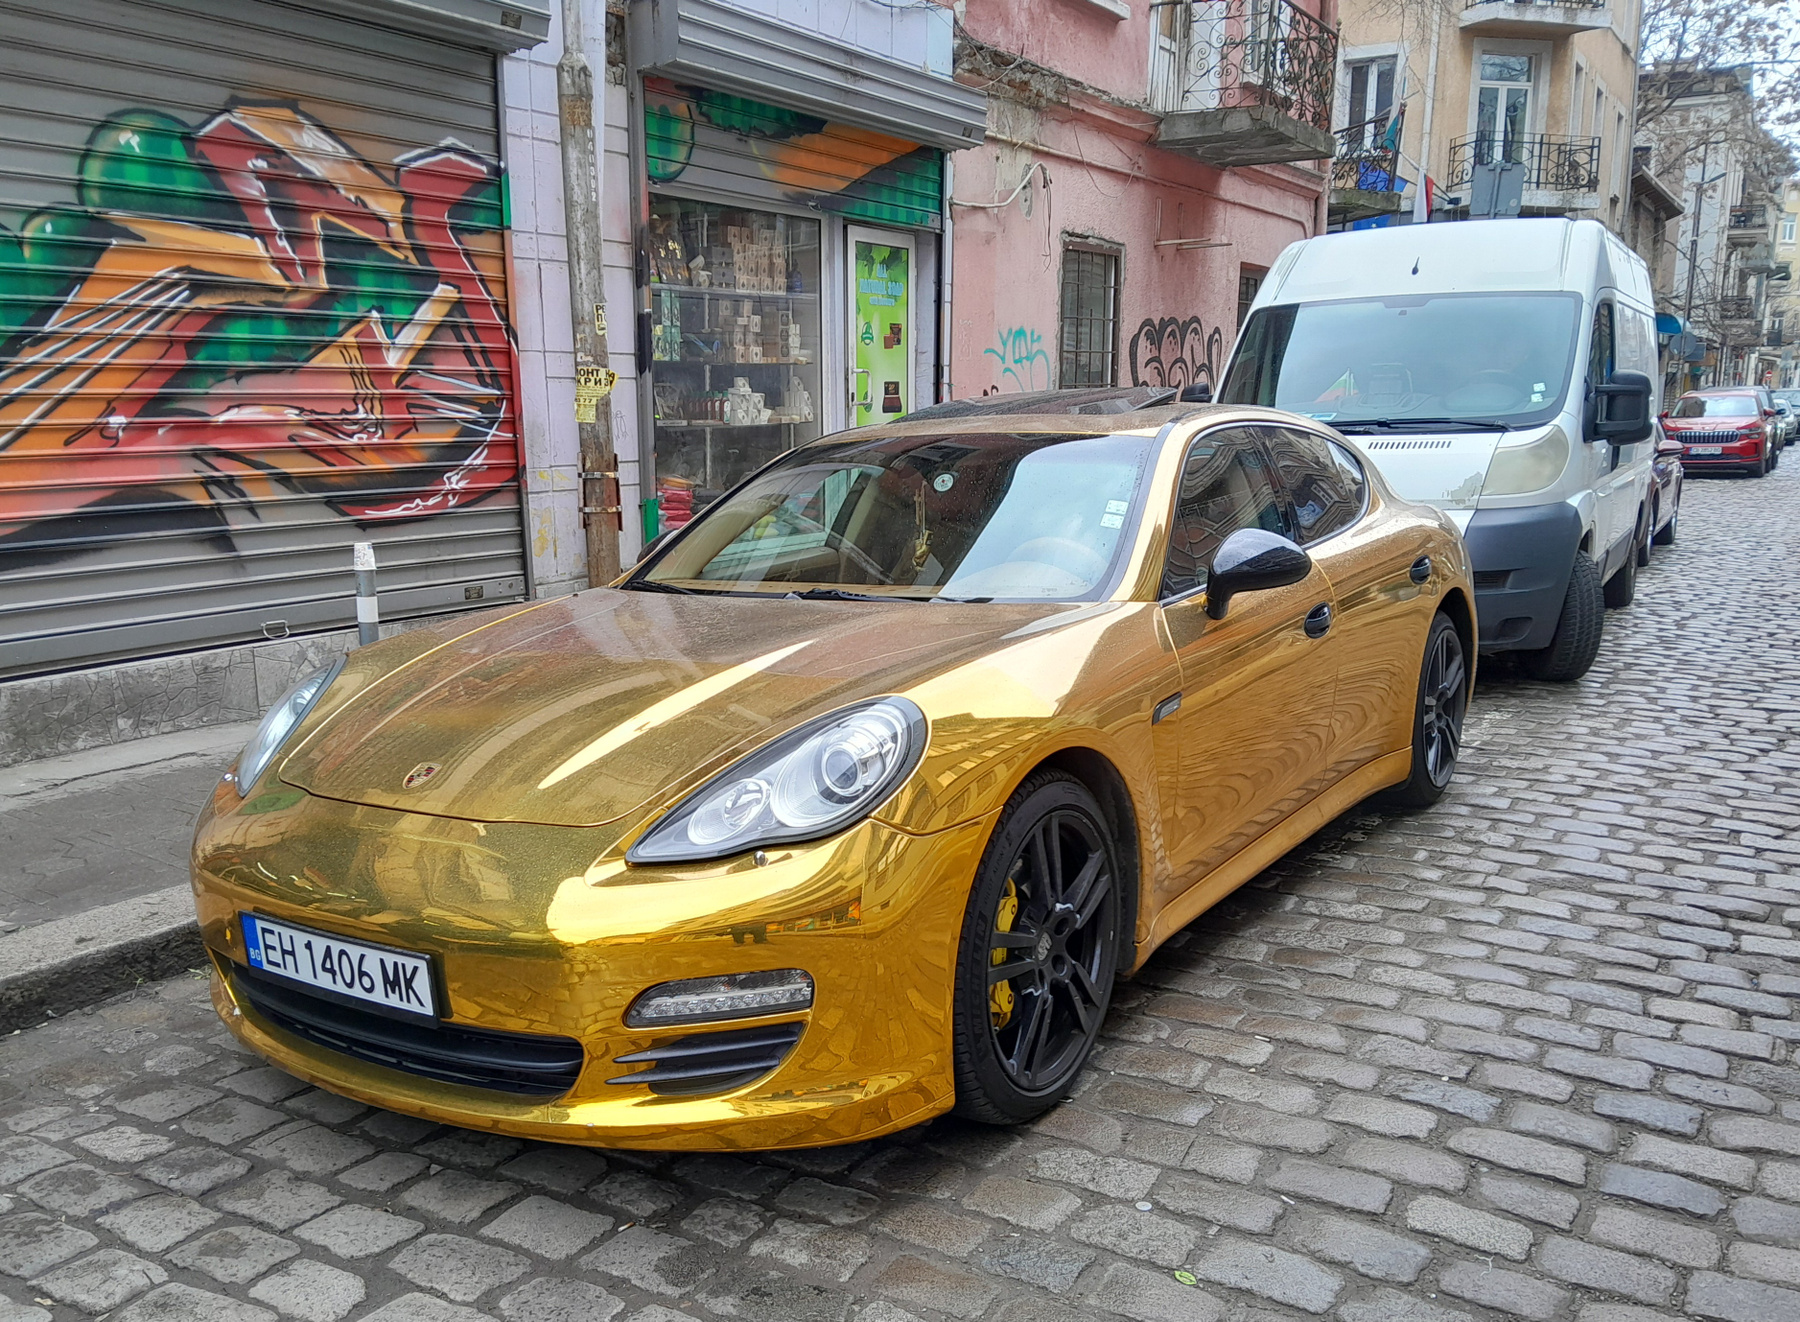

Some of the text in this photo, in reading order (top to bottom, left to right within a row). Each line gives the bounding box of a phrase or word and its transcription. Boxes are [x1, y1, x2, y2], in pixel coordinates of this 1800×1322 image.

[249, 947, 262, 961] BG
[260, 926, 427, 1008] EH 1406 MK
